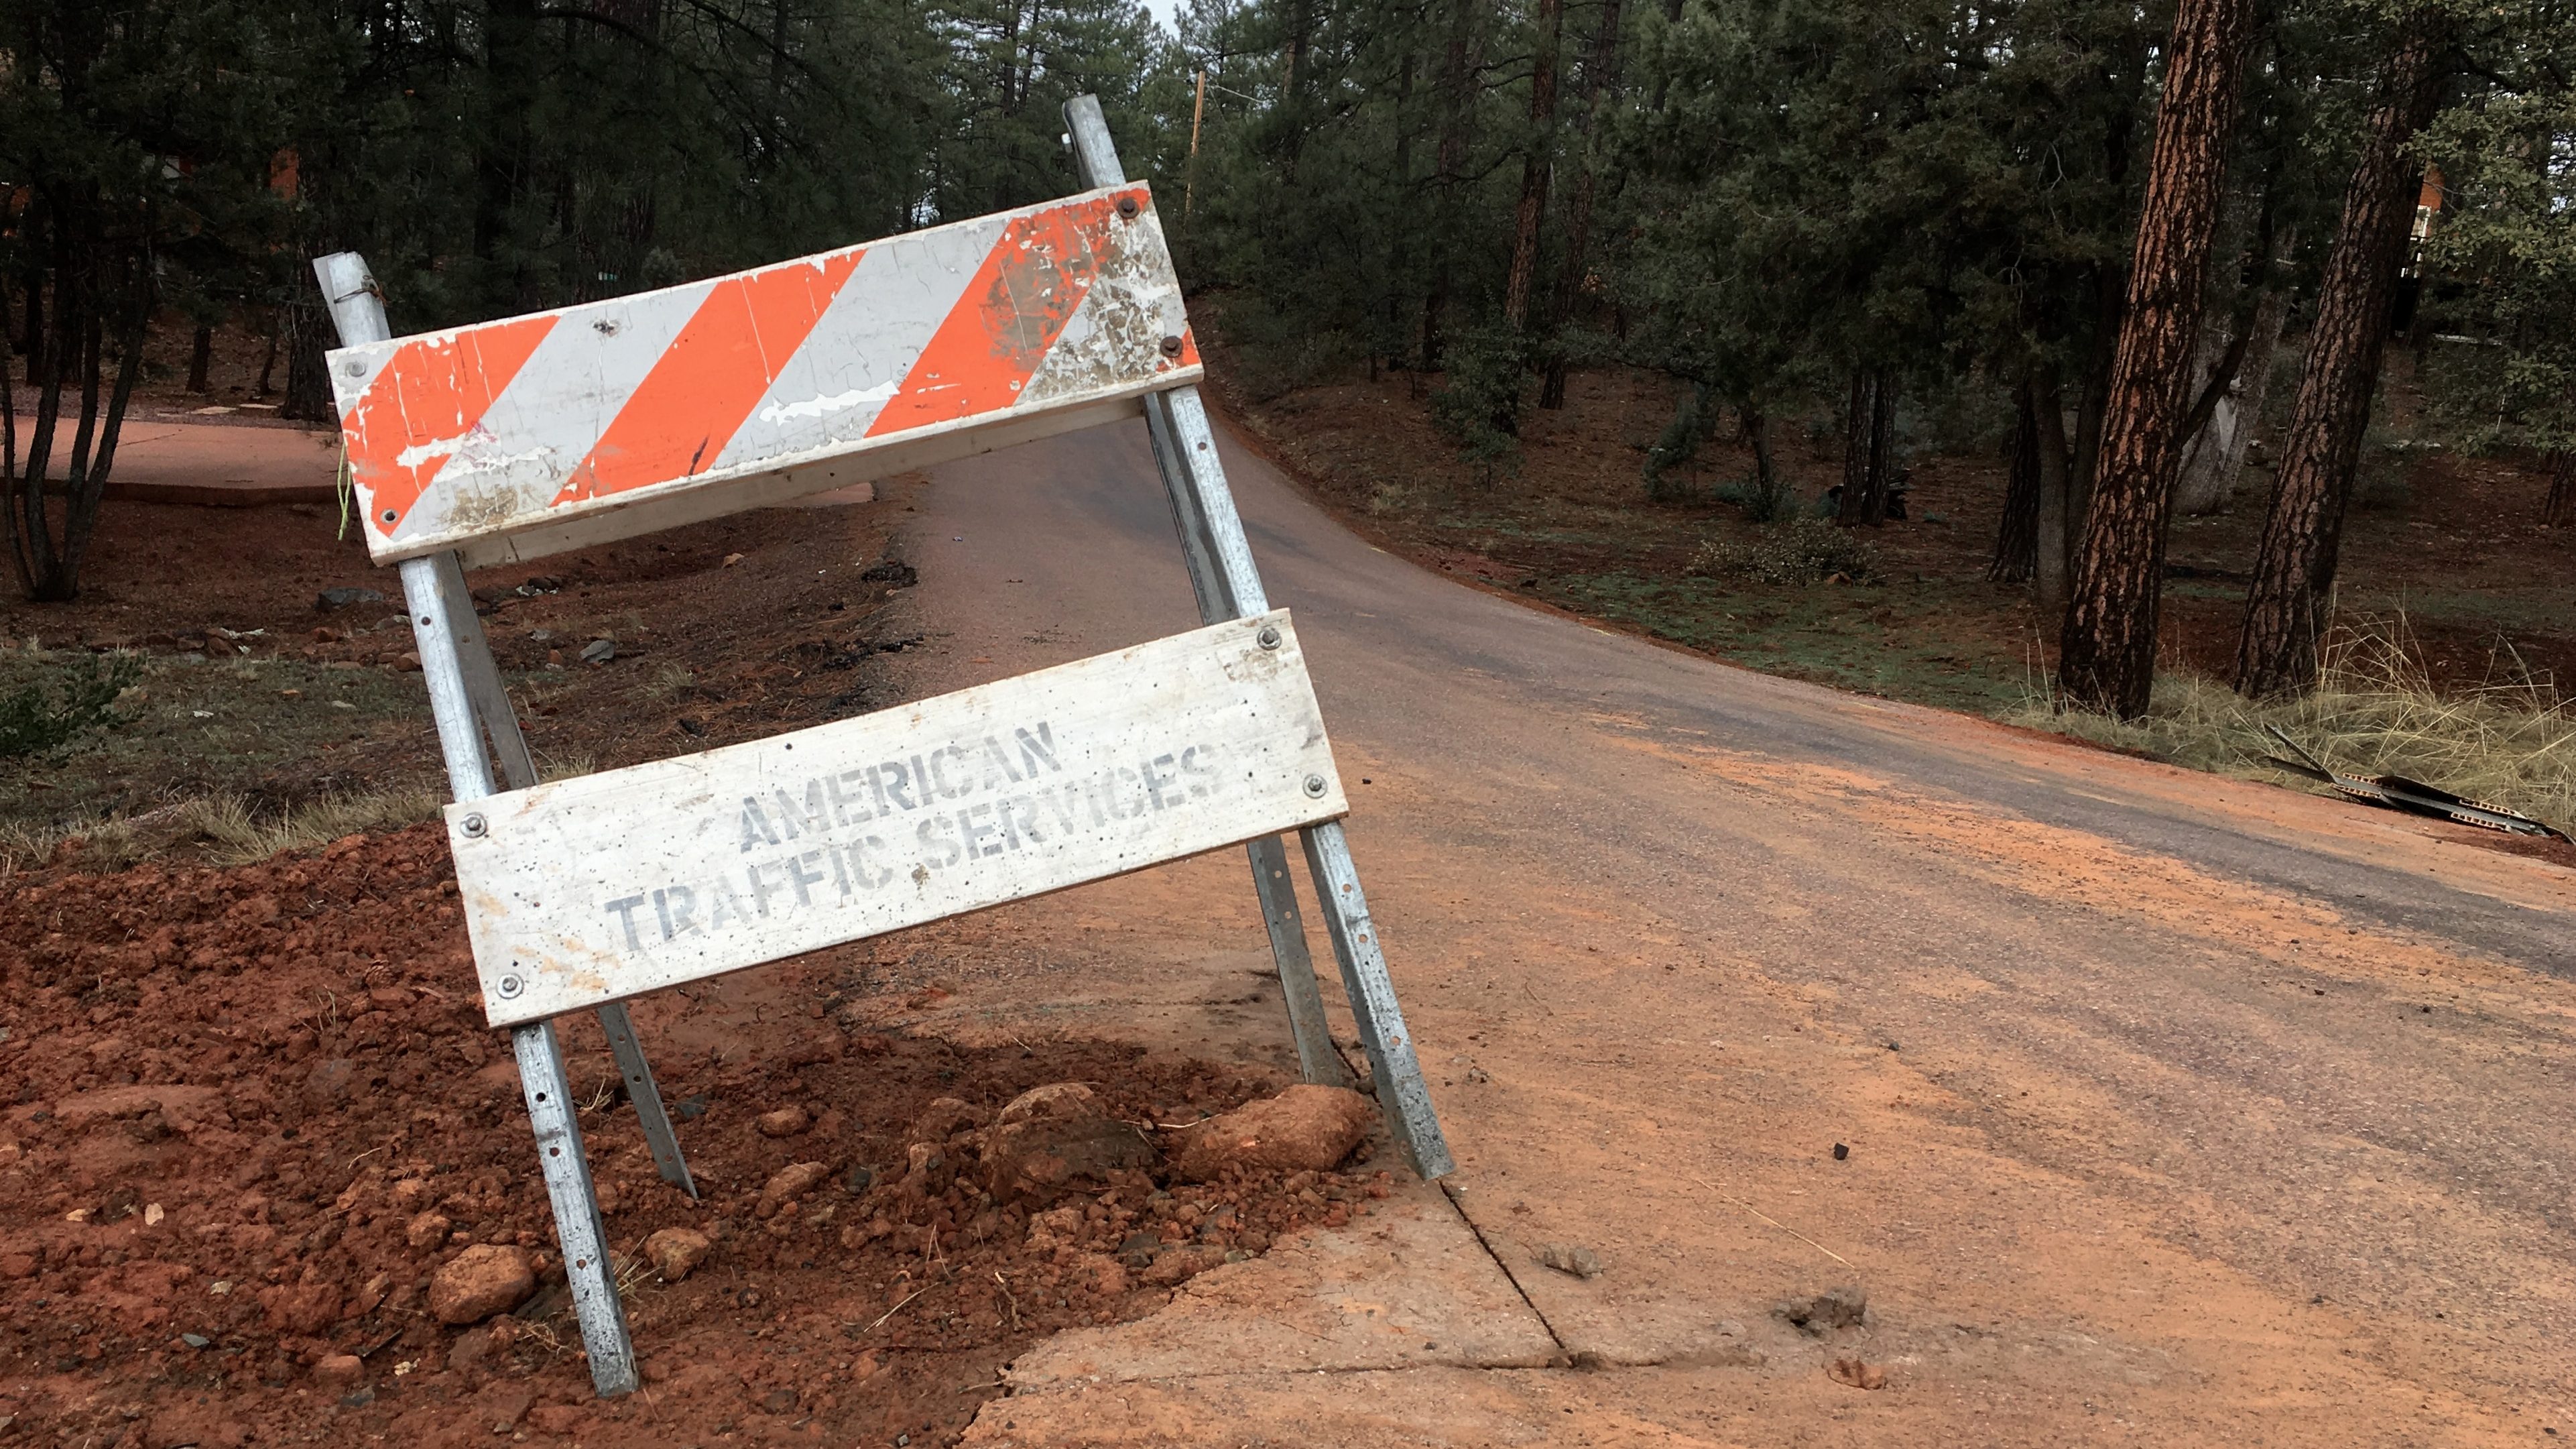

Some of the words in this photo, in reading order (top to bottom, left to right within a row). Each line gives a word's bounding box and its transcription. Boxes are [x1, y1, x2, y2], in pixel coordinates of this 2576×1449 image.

[605, 835, 894, 951] TRAFFIC
[916, 743, 1225, 870] SERVICES
[739, 722, 1062, 852] AMERICAN
